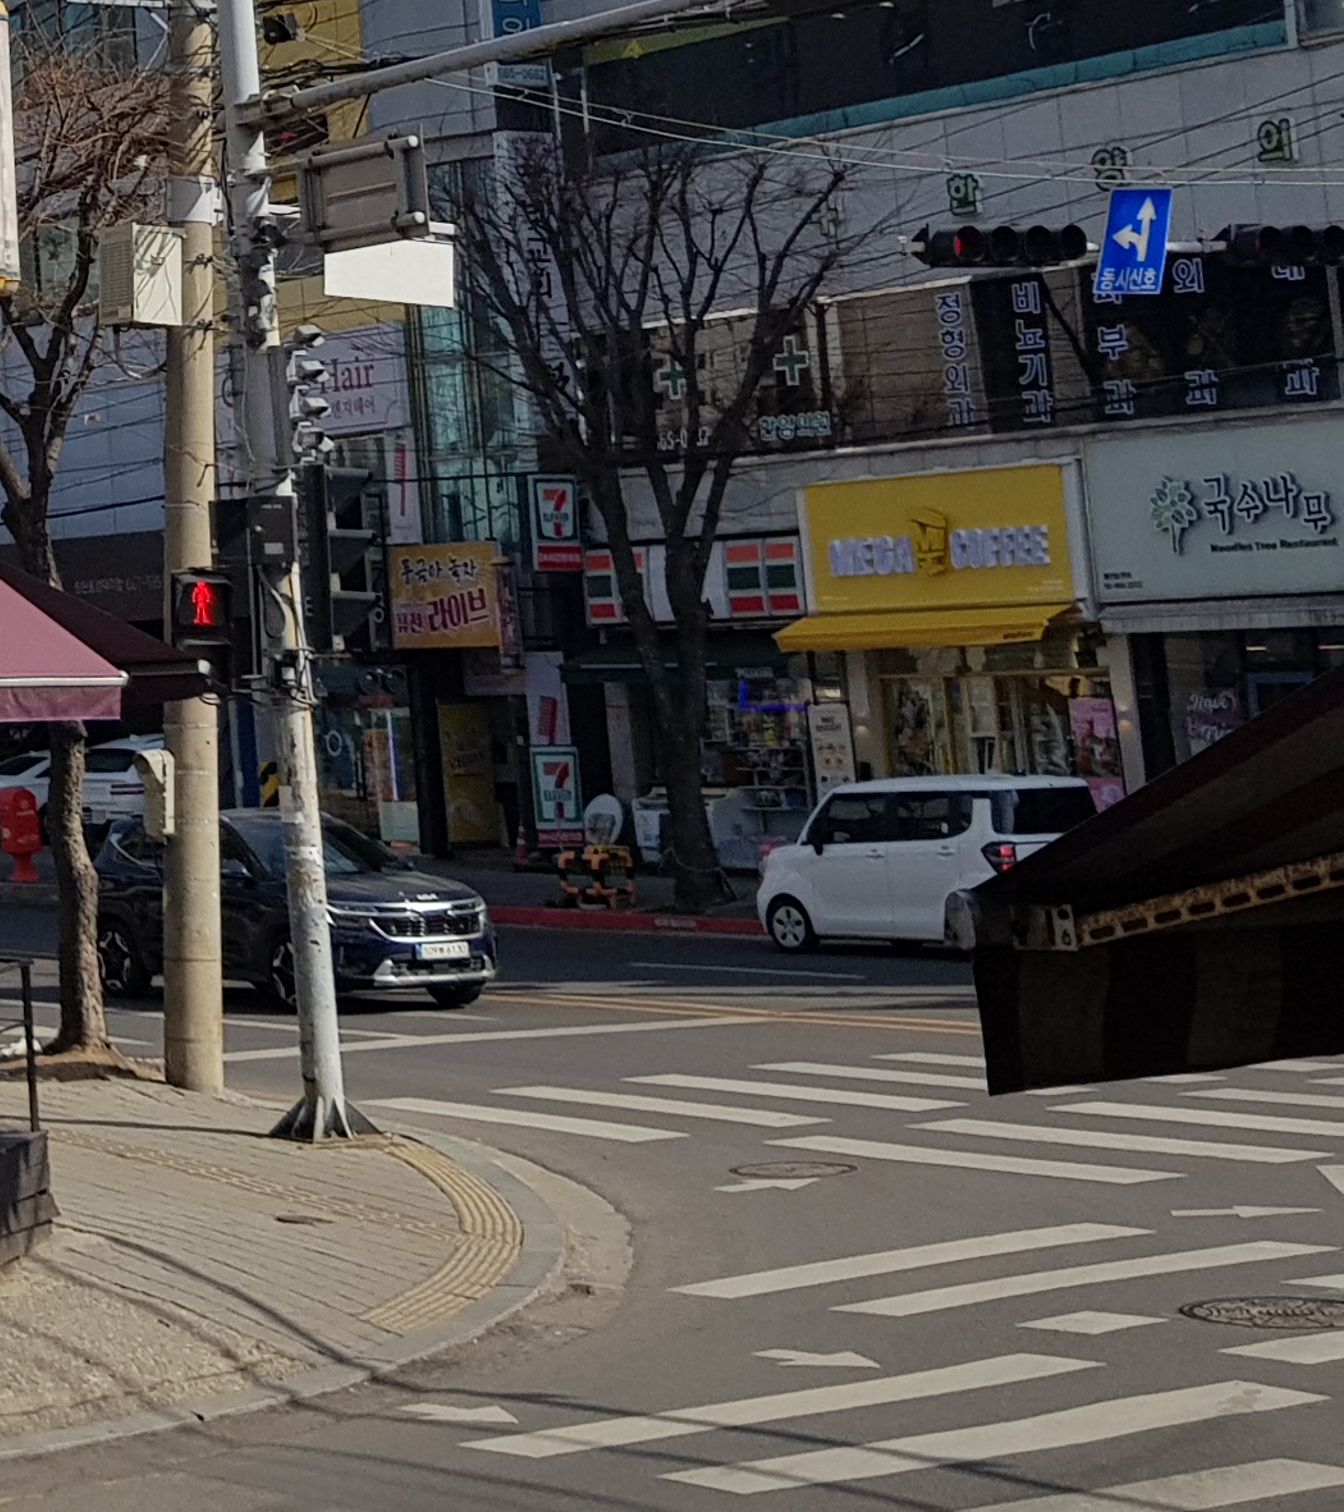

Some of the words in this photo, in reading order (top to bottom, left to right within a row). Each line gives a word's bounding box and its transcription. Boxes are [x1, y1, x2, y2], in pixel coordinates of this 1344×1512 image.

[1099, 267, 1157, 290] 동시신호
[935, 292, 976, 430] 정형외과
[1012, 281, 1054, 423] 비뇨기과
[1201, 472, 1332, 535] 국수나무
[829, 535, 916, 577] MEGA
[949, 524, 1052, 570] COFFEE
[1279, 537, 1339, 548] Restaurant
[427, 588, 490, 632] 라이브
